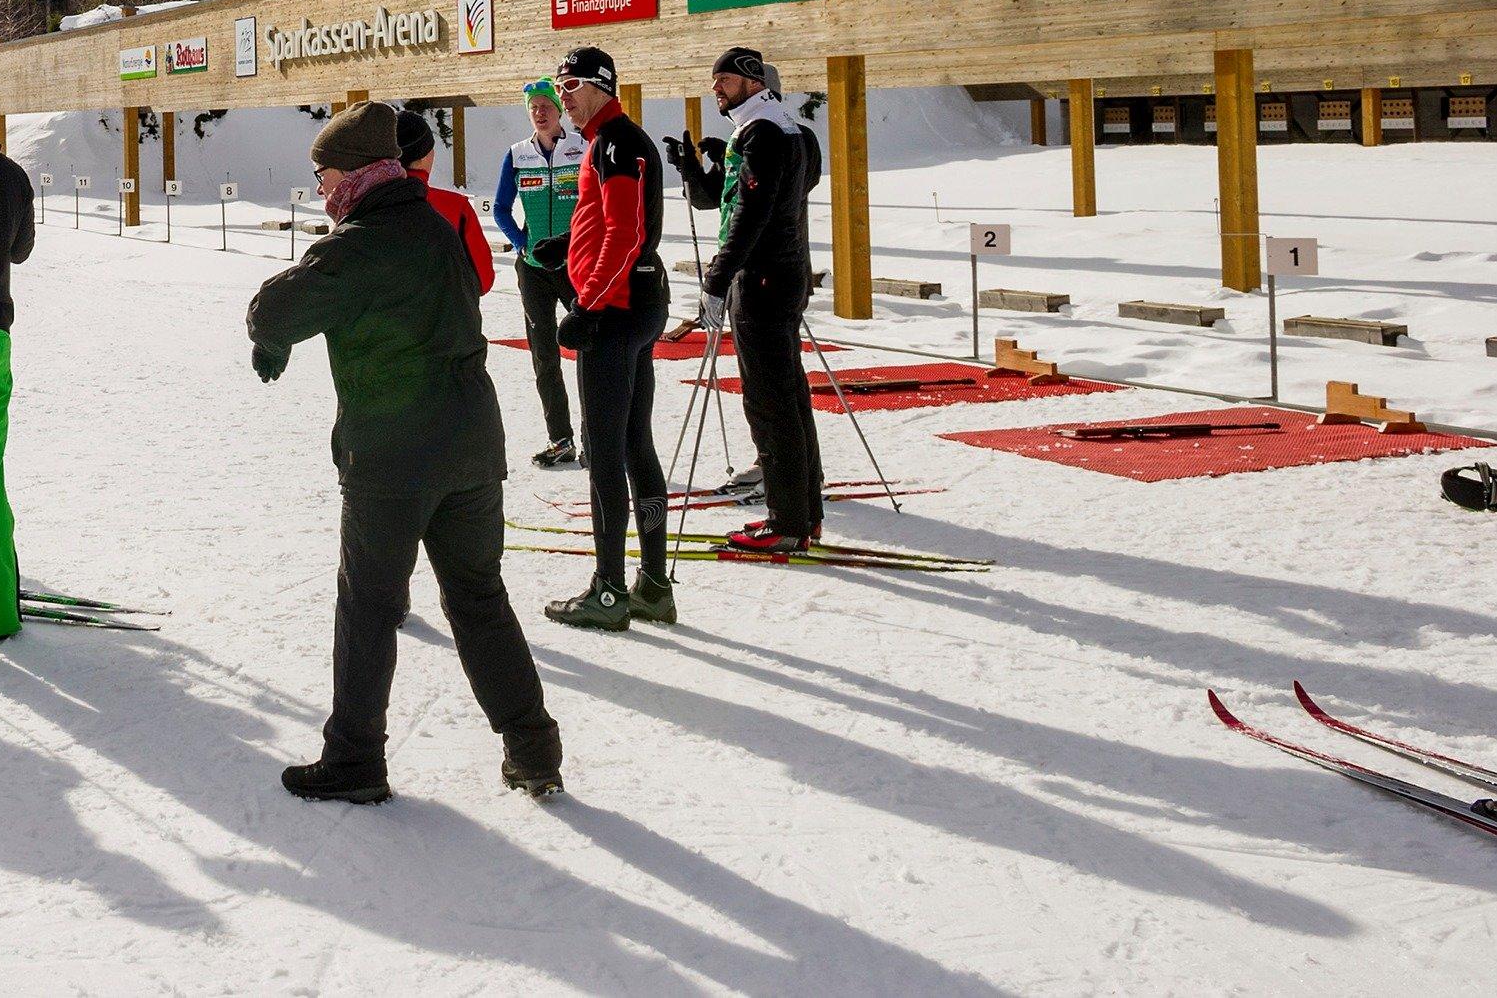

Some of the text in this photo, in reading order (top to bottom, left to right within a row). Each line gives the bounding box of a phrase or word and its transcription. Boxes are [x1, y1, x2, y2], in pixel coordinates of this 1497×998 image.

[264, 5, 440, 71] Sparkassen-Arena
[42, 176, 51, 184] 12
[122, 182, 132, 190] 10
[171, 184, 177, 192] 9
[226, 187, 233, 196] 8
[297, 191, 304, 201] 7
[482, 201, 490, 212] 5
[984, 231, 997, 248] 2
[1289, 247, 1299, 267] 1
